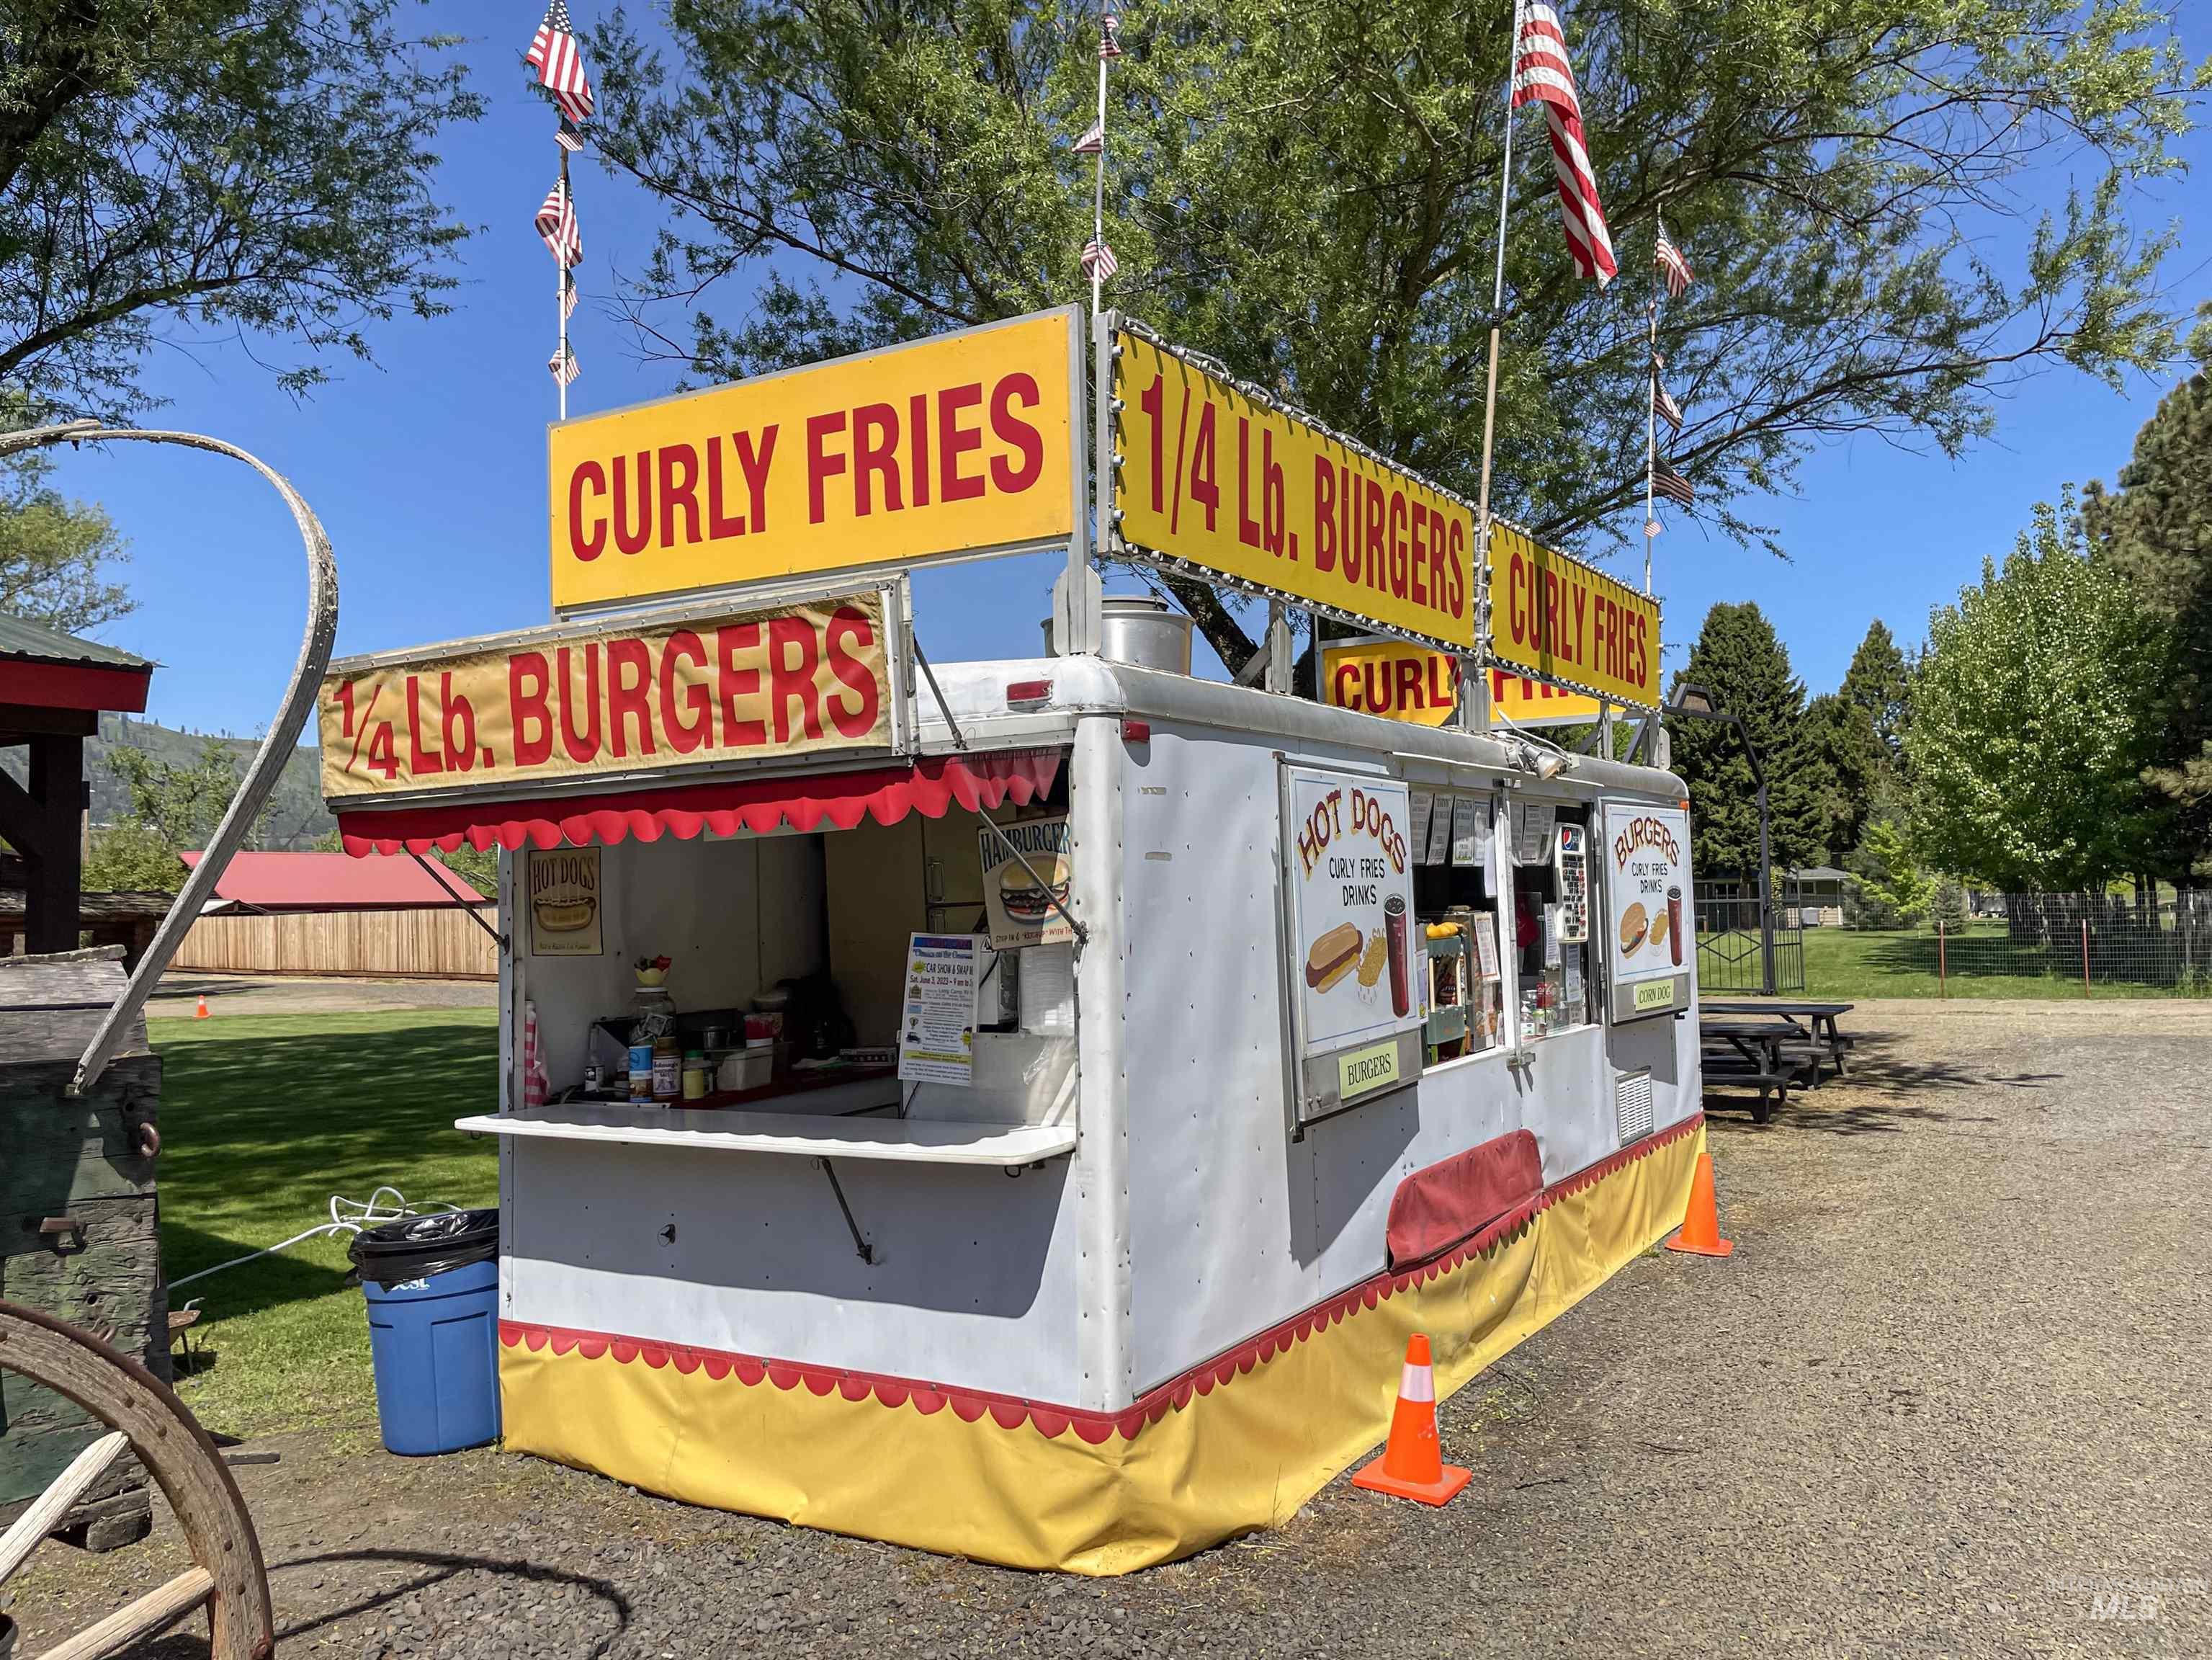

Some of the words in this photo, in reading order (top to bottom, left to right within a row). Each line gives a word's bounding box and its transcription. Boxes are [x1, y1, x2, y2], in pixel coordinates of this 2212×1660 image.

[569, 424, 779, 562] CURLY
[807, 372, 1044, 525] FRIES
[1141, 374, 1219, 535] 1/4
[1237, 416, 1299, 561] Lb.
[1315, 454, 1465, 620] BURGERS
[1510, 552, 1586, 666] CURLY
[1594, 595, 1647, 690] FRIES
[333, 681, 400, 780] 1/4
[406, 671, 495, 775] Lb.
[509, 607, 880, 768] BURGERS
[1297, 787, 1342, 881] HOT
[1351, 787, 1407, 876] DOGS
[1614, 816, 1680, 870] BURGERS
[533, 858, 558, 895] HOT
[560, 857, 595, 891] DOGS
[1329, 857, 1356, 879] CURLY
[1361, 858, 1385, 879] FRIES
[1631, 862, 1649, 877] CURLY
[1652, 862, 1668, 877] FRIES
[1343, 884, 1377, 907] DRINKS
[1639, 878, 1662, 895] DRINKS
[926, 963, 936, 973] CAR
[938, 963, 951, 974] SHOW
[957, 963, 969, 975] SWAP
[1639, 988, 1657, 1004] CORN
[1658, 986, 1670, 1000] DOG
[1348, 1053, 1392, 1085] BURGERS
